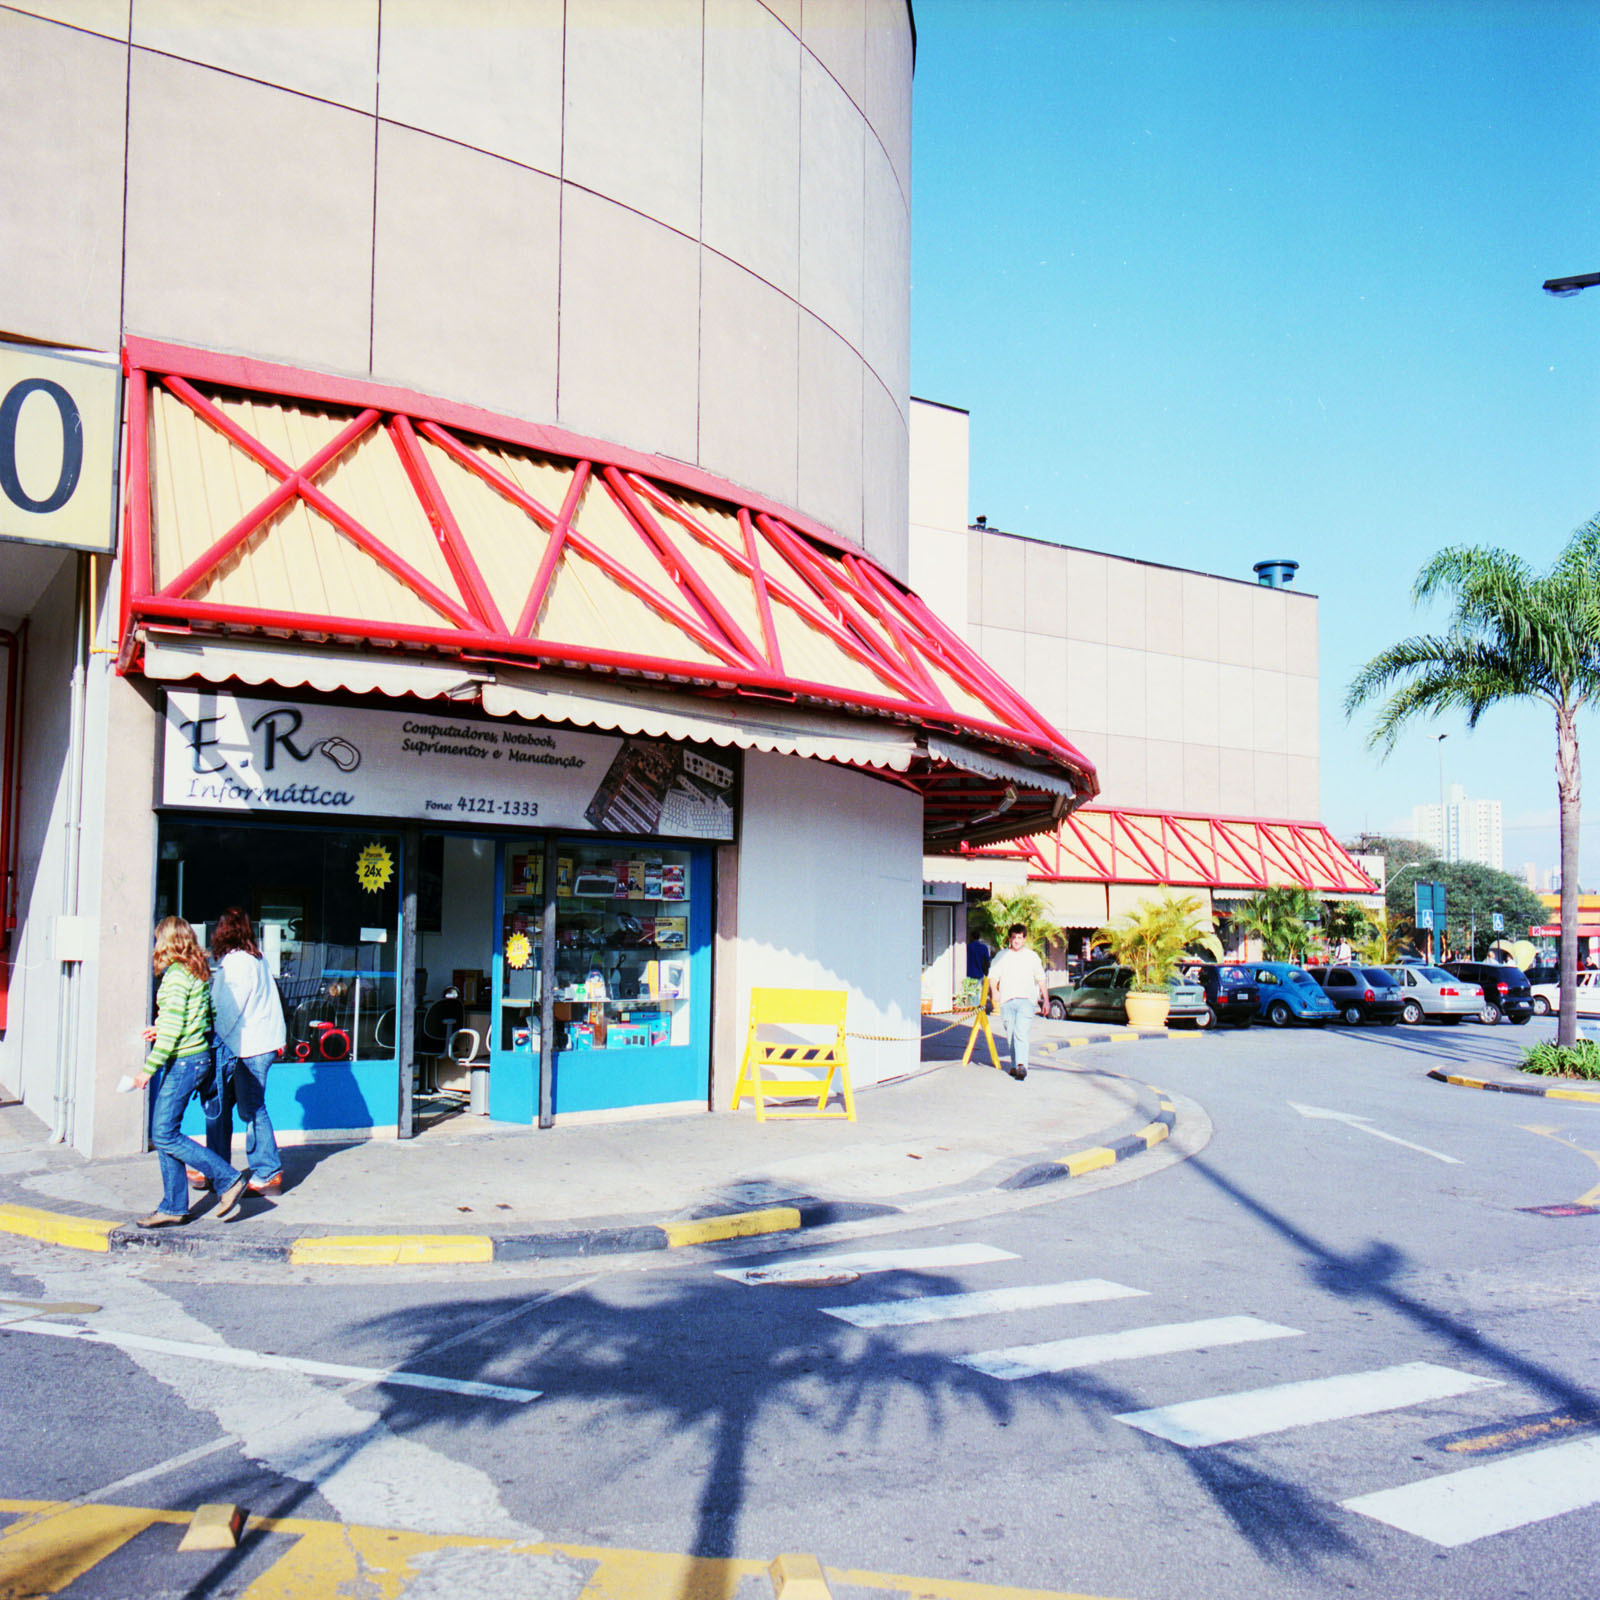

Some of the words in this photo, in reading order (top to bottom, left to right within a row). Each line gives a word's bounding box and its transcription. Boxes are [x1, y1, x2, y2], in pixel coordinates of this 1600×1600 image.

[402, 738, 488, 759] Suprimentos
[492, 750, 503, 759] e
[508, 749, 586, 768] Manutenção
[186, 777, 355, 806] Informática
[425, 800, 453, 811] Fone:
[457, 796, 539, 817] 4121-1333
[364, 865, 382, 877] 24x
